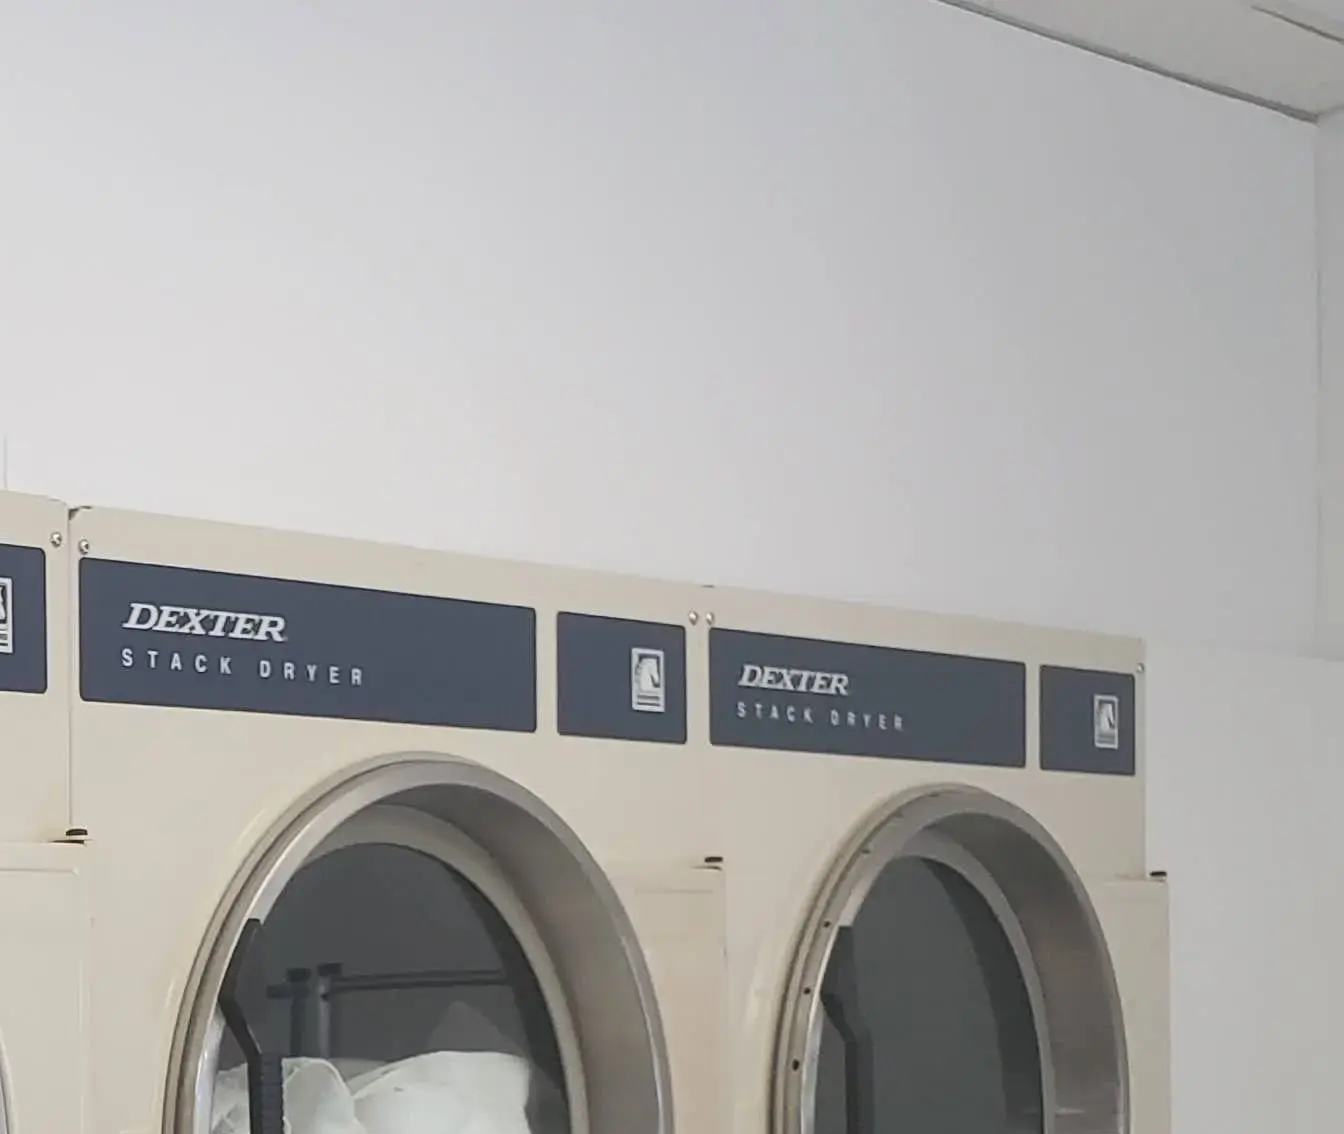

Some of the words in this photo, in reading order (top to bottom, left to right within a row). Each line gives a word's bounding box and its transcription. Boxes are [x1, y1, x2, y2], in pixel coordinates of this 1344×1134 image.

[122, 603, 286, 642] DEXTER
[121, 648, 232, 675] STACK
[259, 660, 362, 685] DRYER
[738, 664, 849, 696] DEXTER
[737, 701, 814, 723] STACK
[830, 708, 904, 731] DRYER
